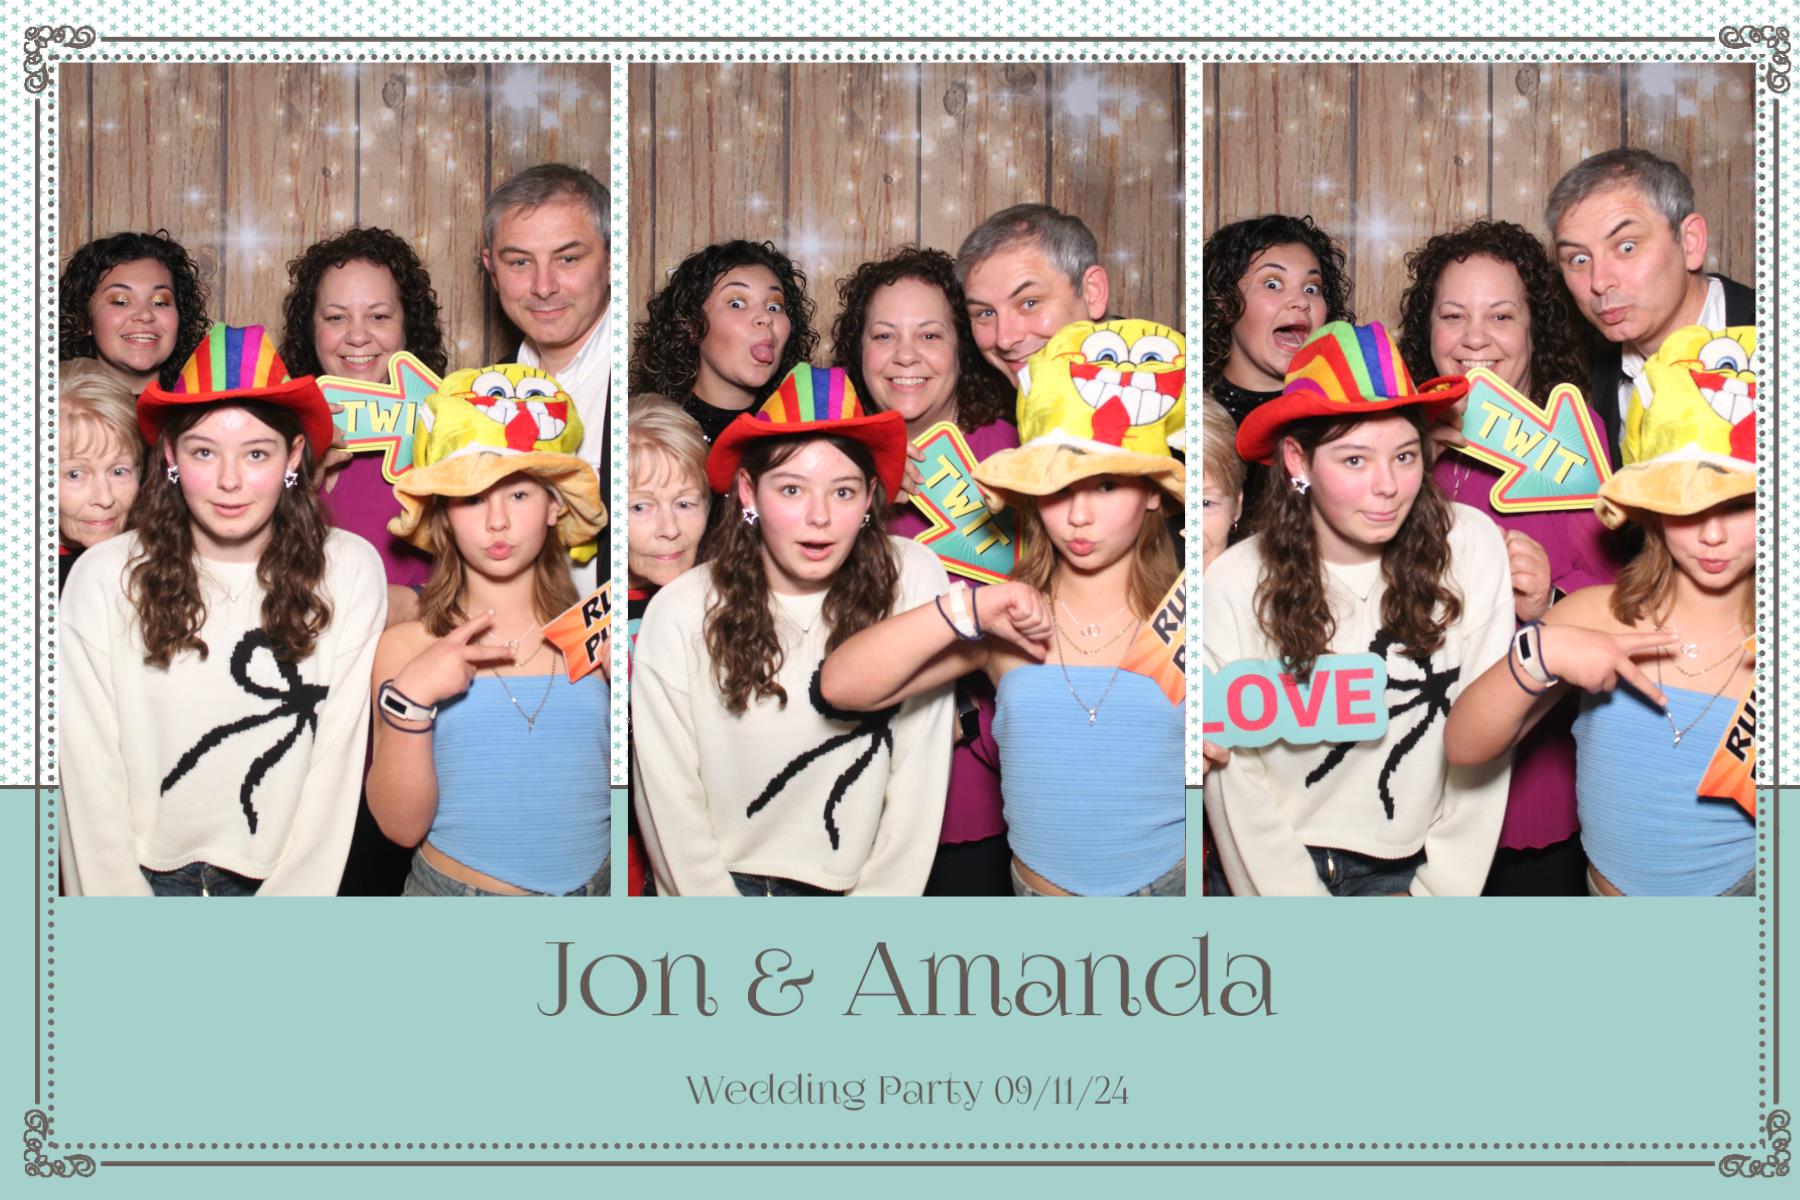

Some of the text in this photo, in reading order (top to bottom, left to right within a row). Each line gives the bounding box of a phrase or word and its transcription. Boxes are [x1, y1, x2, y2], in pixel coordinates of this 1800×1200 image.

[338, 400, 417, 436] TWI
[1478, 400, 1587, 485] TWIT
[926, 454, 1011, 556] TWIT
[1152, 578, 1186, 646] RU
[1725, 689, 1756, 762] RU
